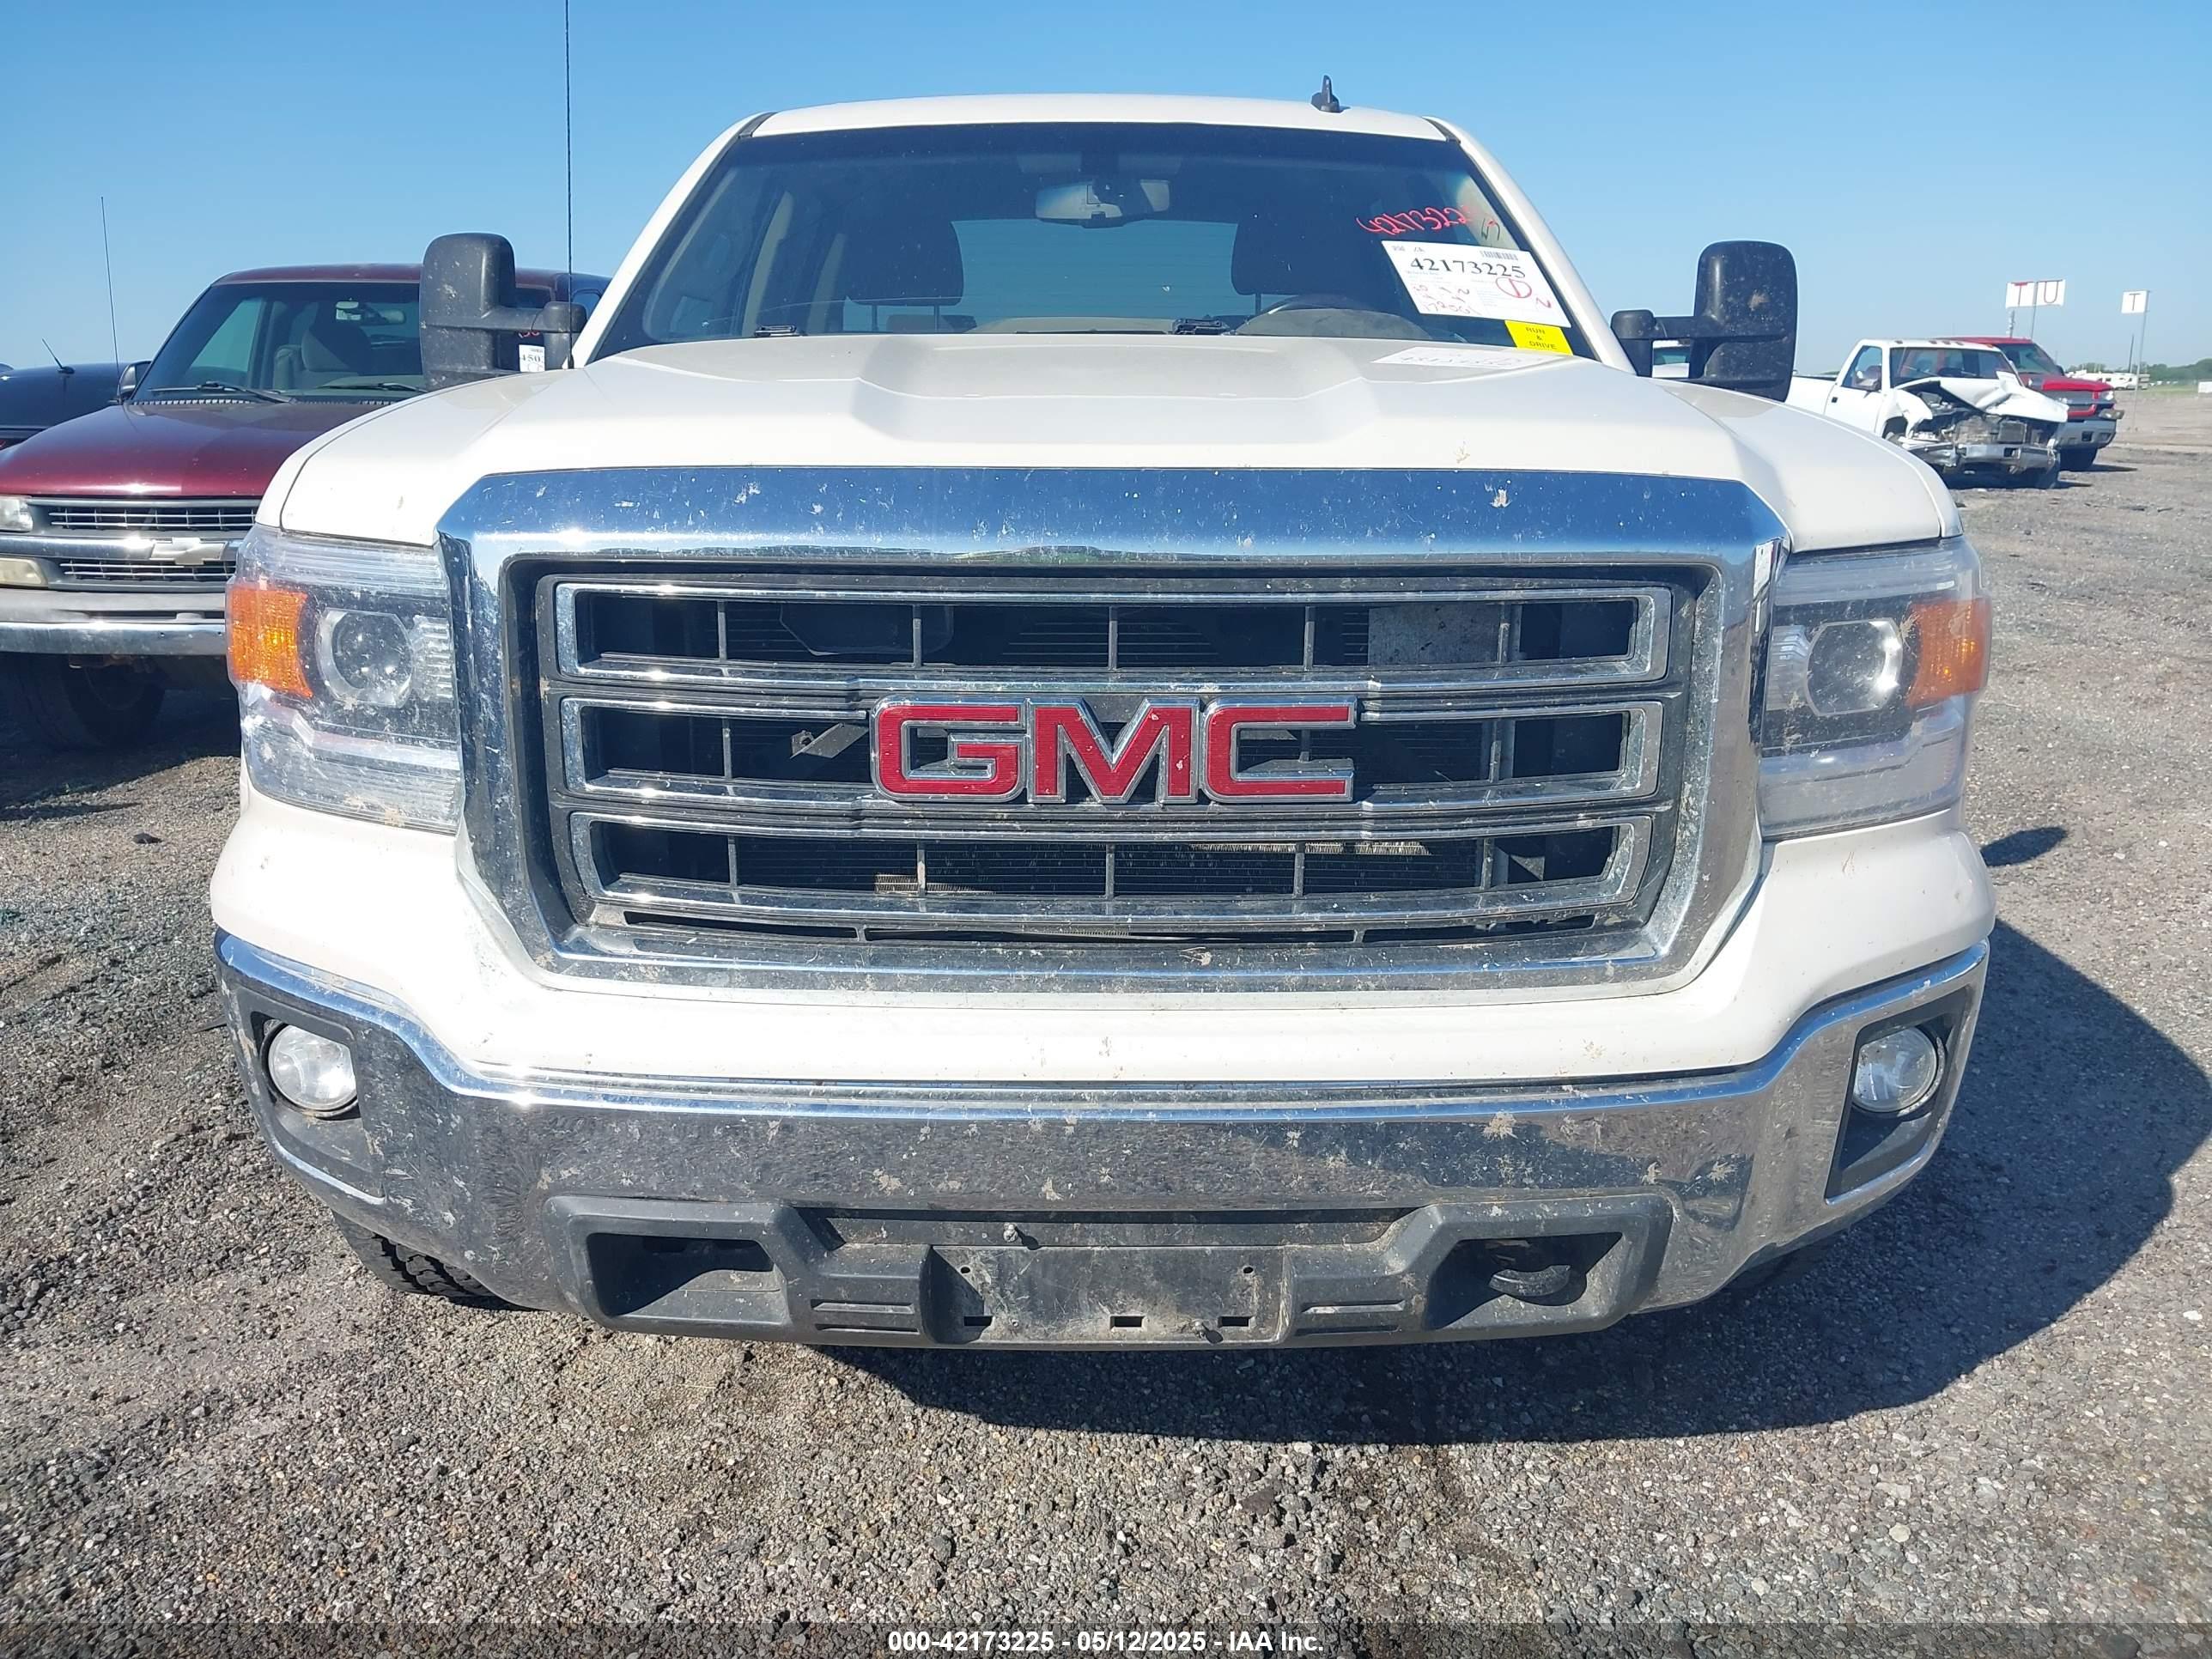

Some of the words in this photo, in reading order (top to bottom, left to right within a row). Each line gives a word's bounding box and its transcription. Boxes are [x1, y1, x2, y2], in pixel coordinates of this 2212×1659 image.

[1410, 257, 1526, 279] 42173225
[2013, 282, 2031, 307] T
[2044, 280, 2060, 304] U
[2129, 293, 2141, 311] T
[1525, 326, 1546, 335] RUN
[1528, 340, 1558, 349] DRIVE
[869, 694, 1357, 804] GMC
